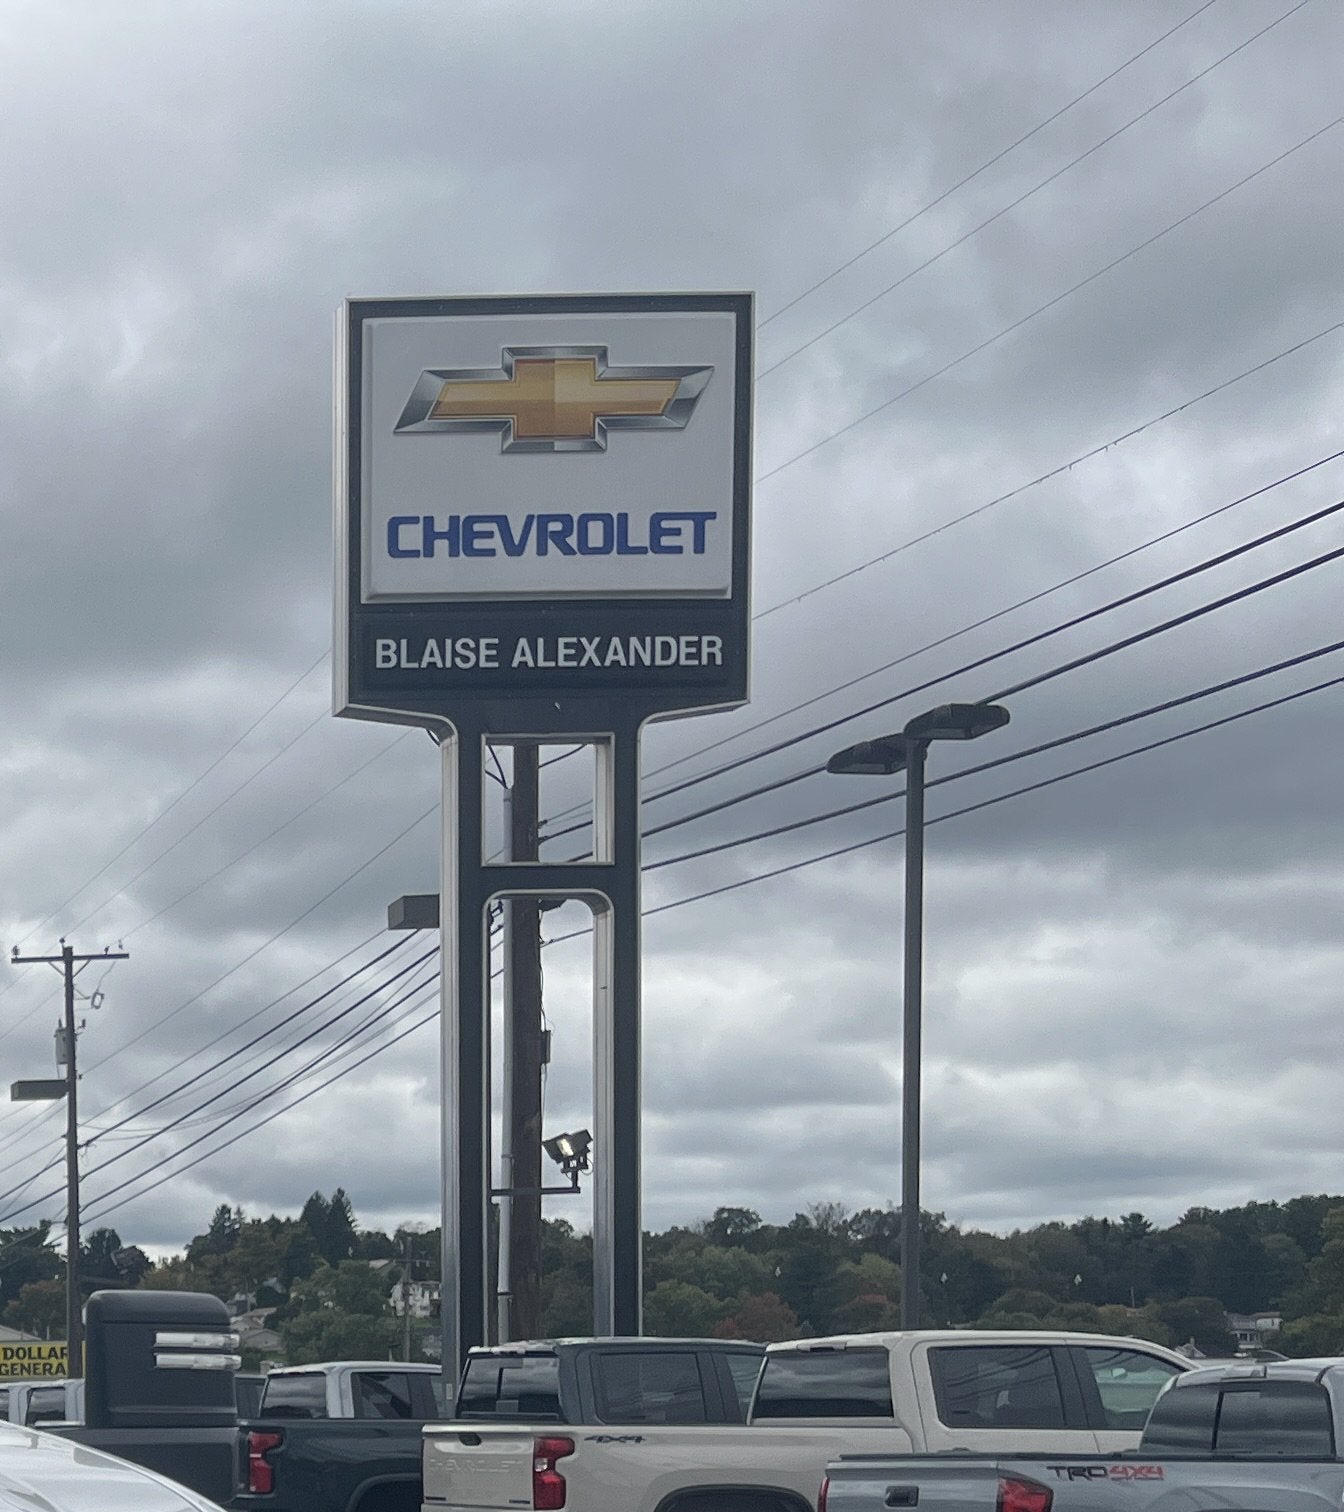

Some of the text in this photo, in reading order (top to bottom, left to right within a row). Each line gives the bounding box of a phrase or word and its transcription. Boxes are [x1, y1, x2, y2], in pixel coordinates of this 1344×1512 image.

[387, 511, 717, 559] CHEVROLET
[375, 635, 723, 669] BLAISE ALEXANDER
